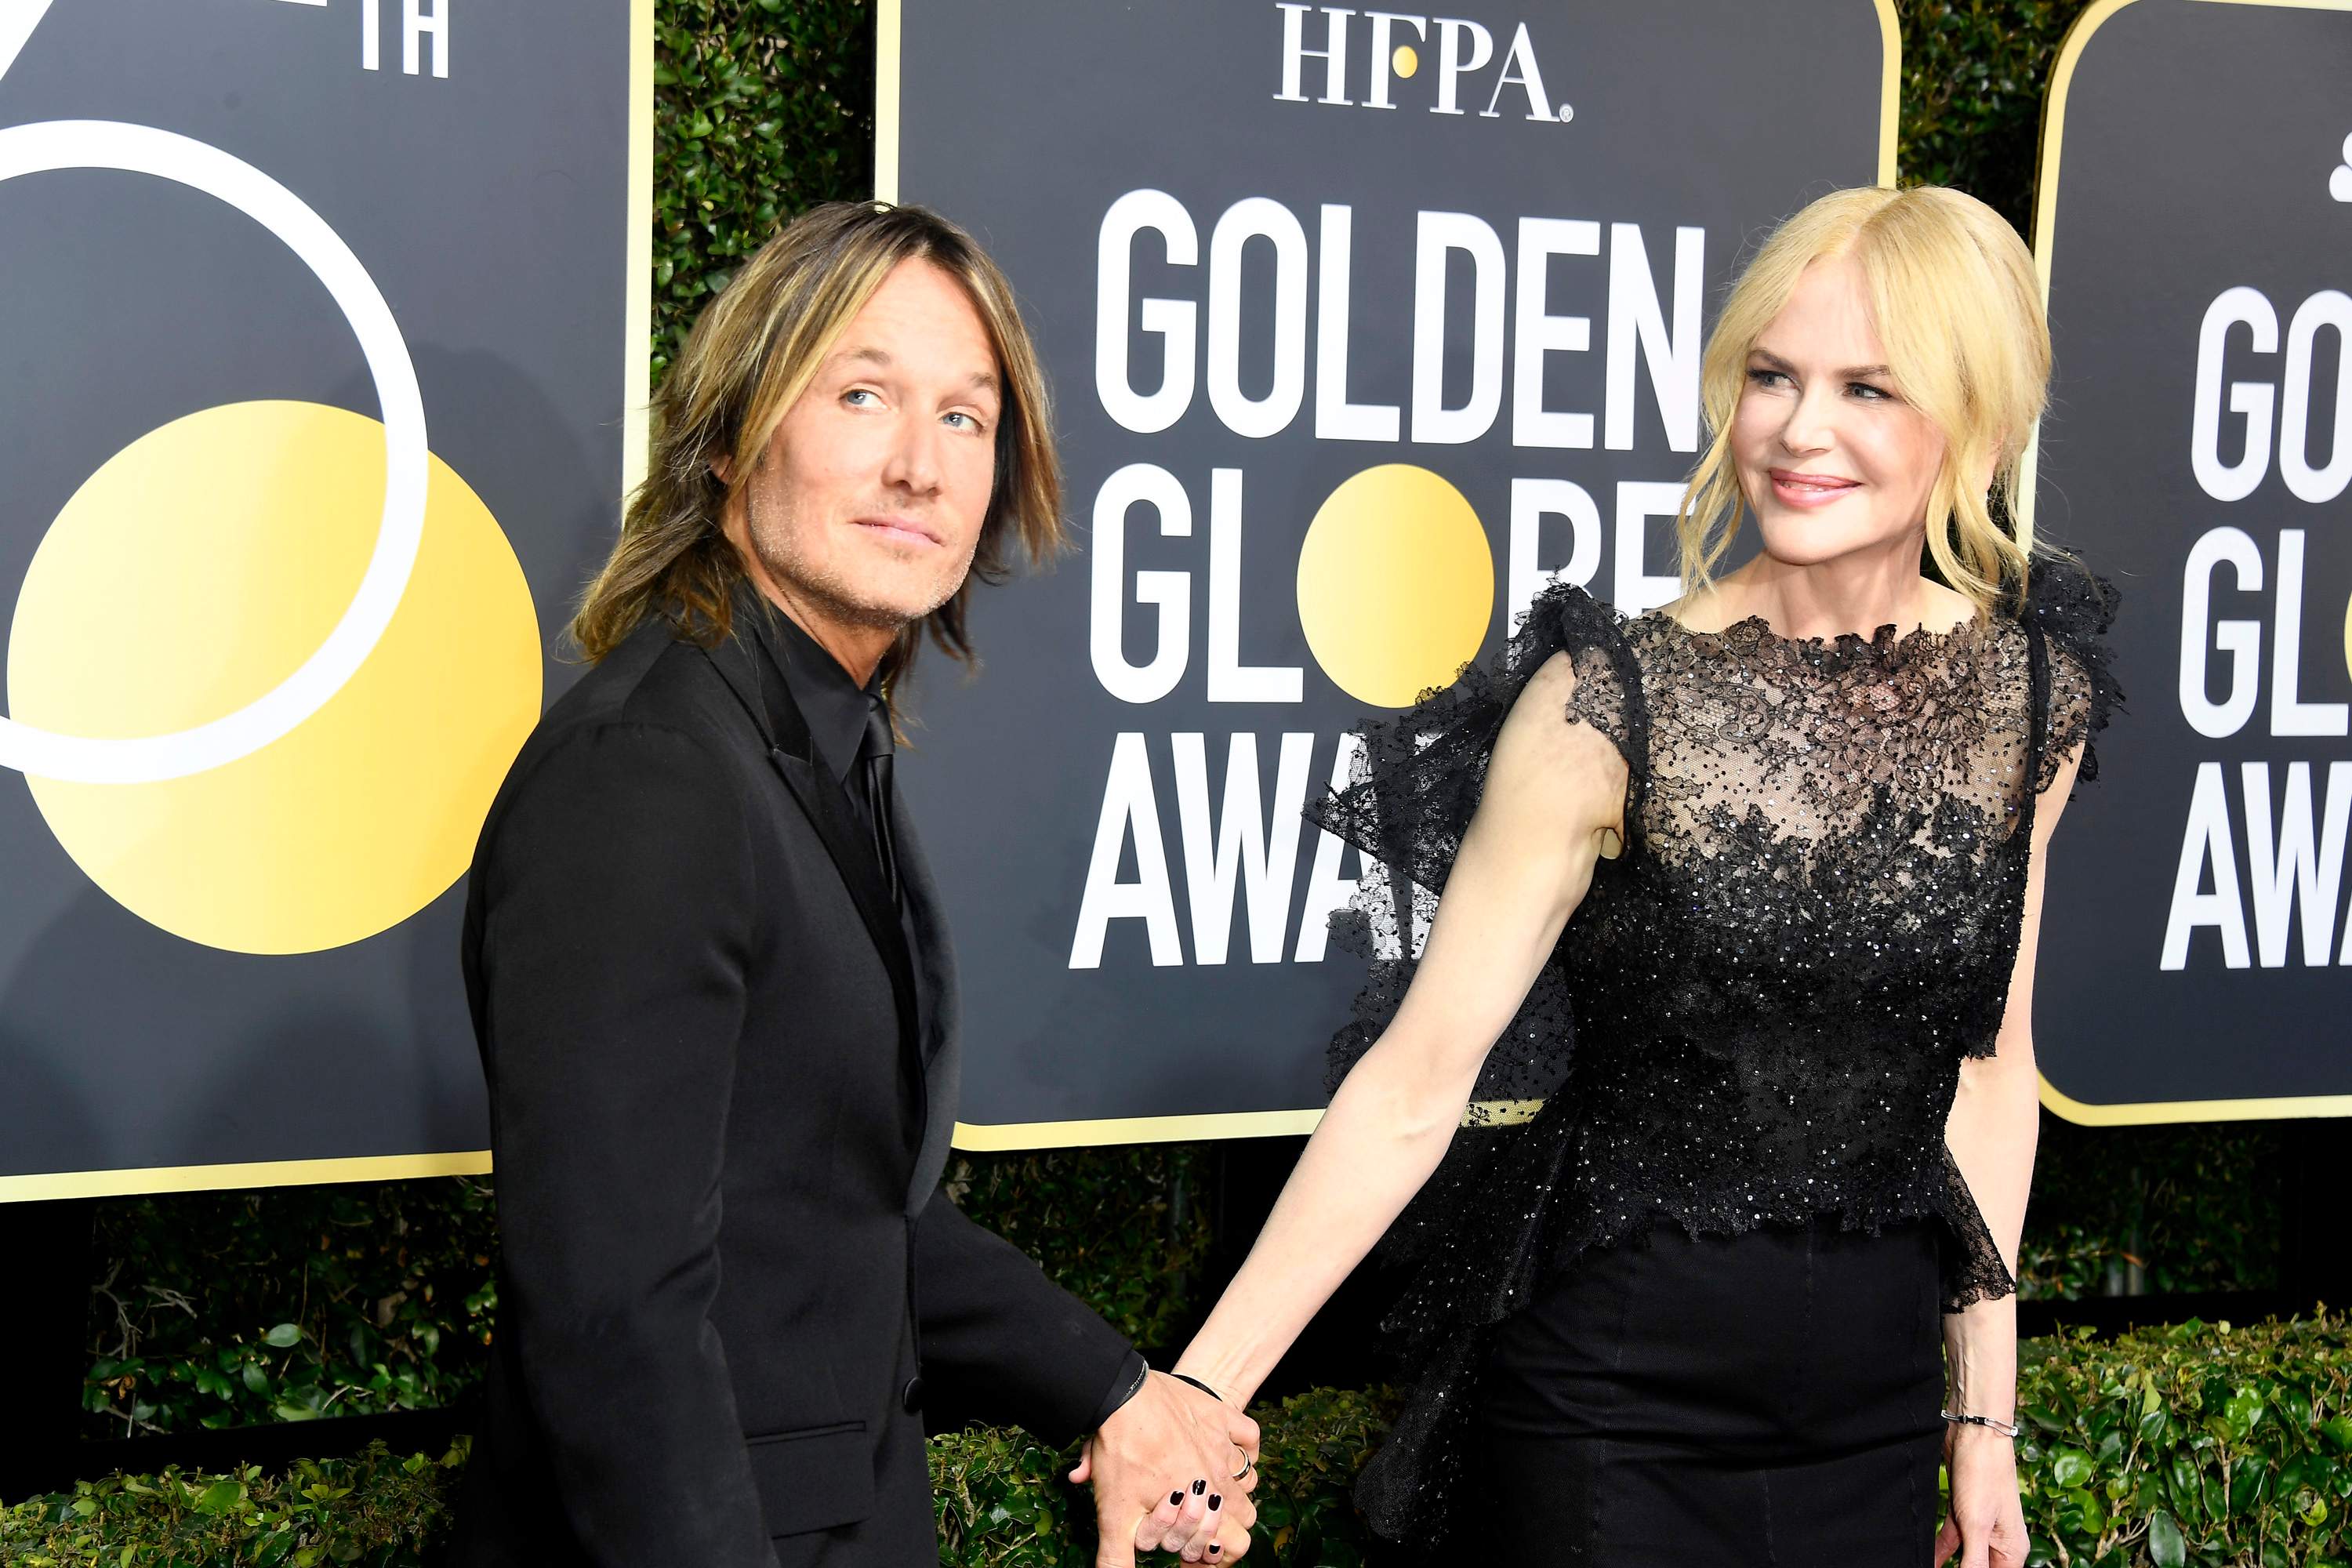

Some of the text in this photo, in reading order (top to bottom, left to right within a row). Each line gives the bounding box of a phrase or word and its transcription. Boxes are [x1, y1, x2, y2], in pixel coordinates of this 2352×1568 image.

[1095, 188, 1715, 453] GOLDEN
[2191, 286, 2352, 503] GO
[2179, 526, 2352, 739] GL
[1068, 731, 1444, 970] AWA
[2160, 760, 2352, 971] AW
